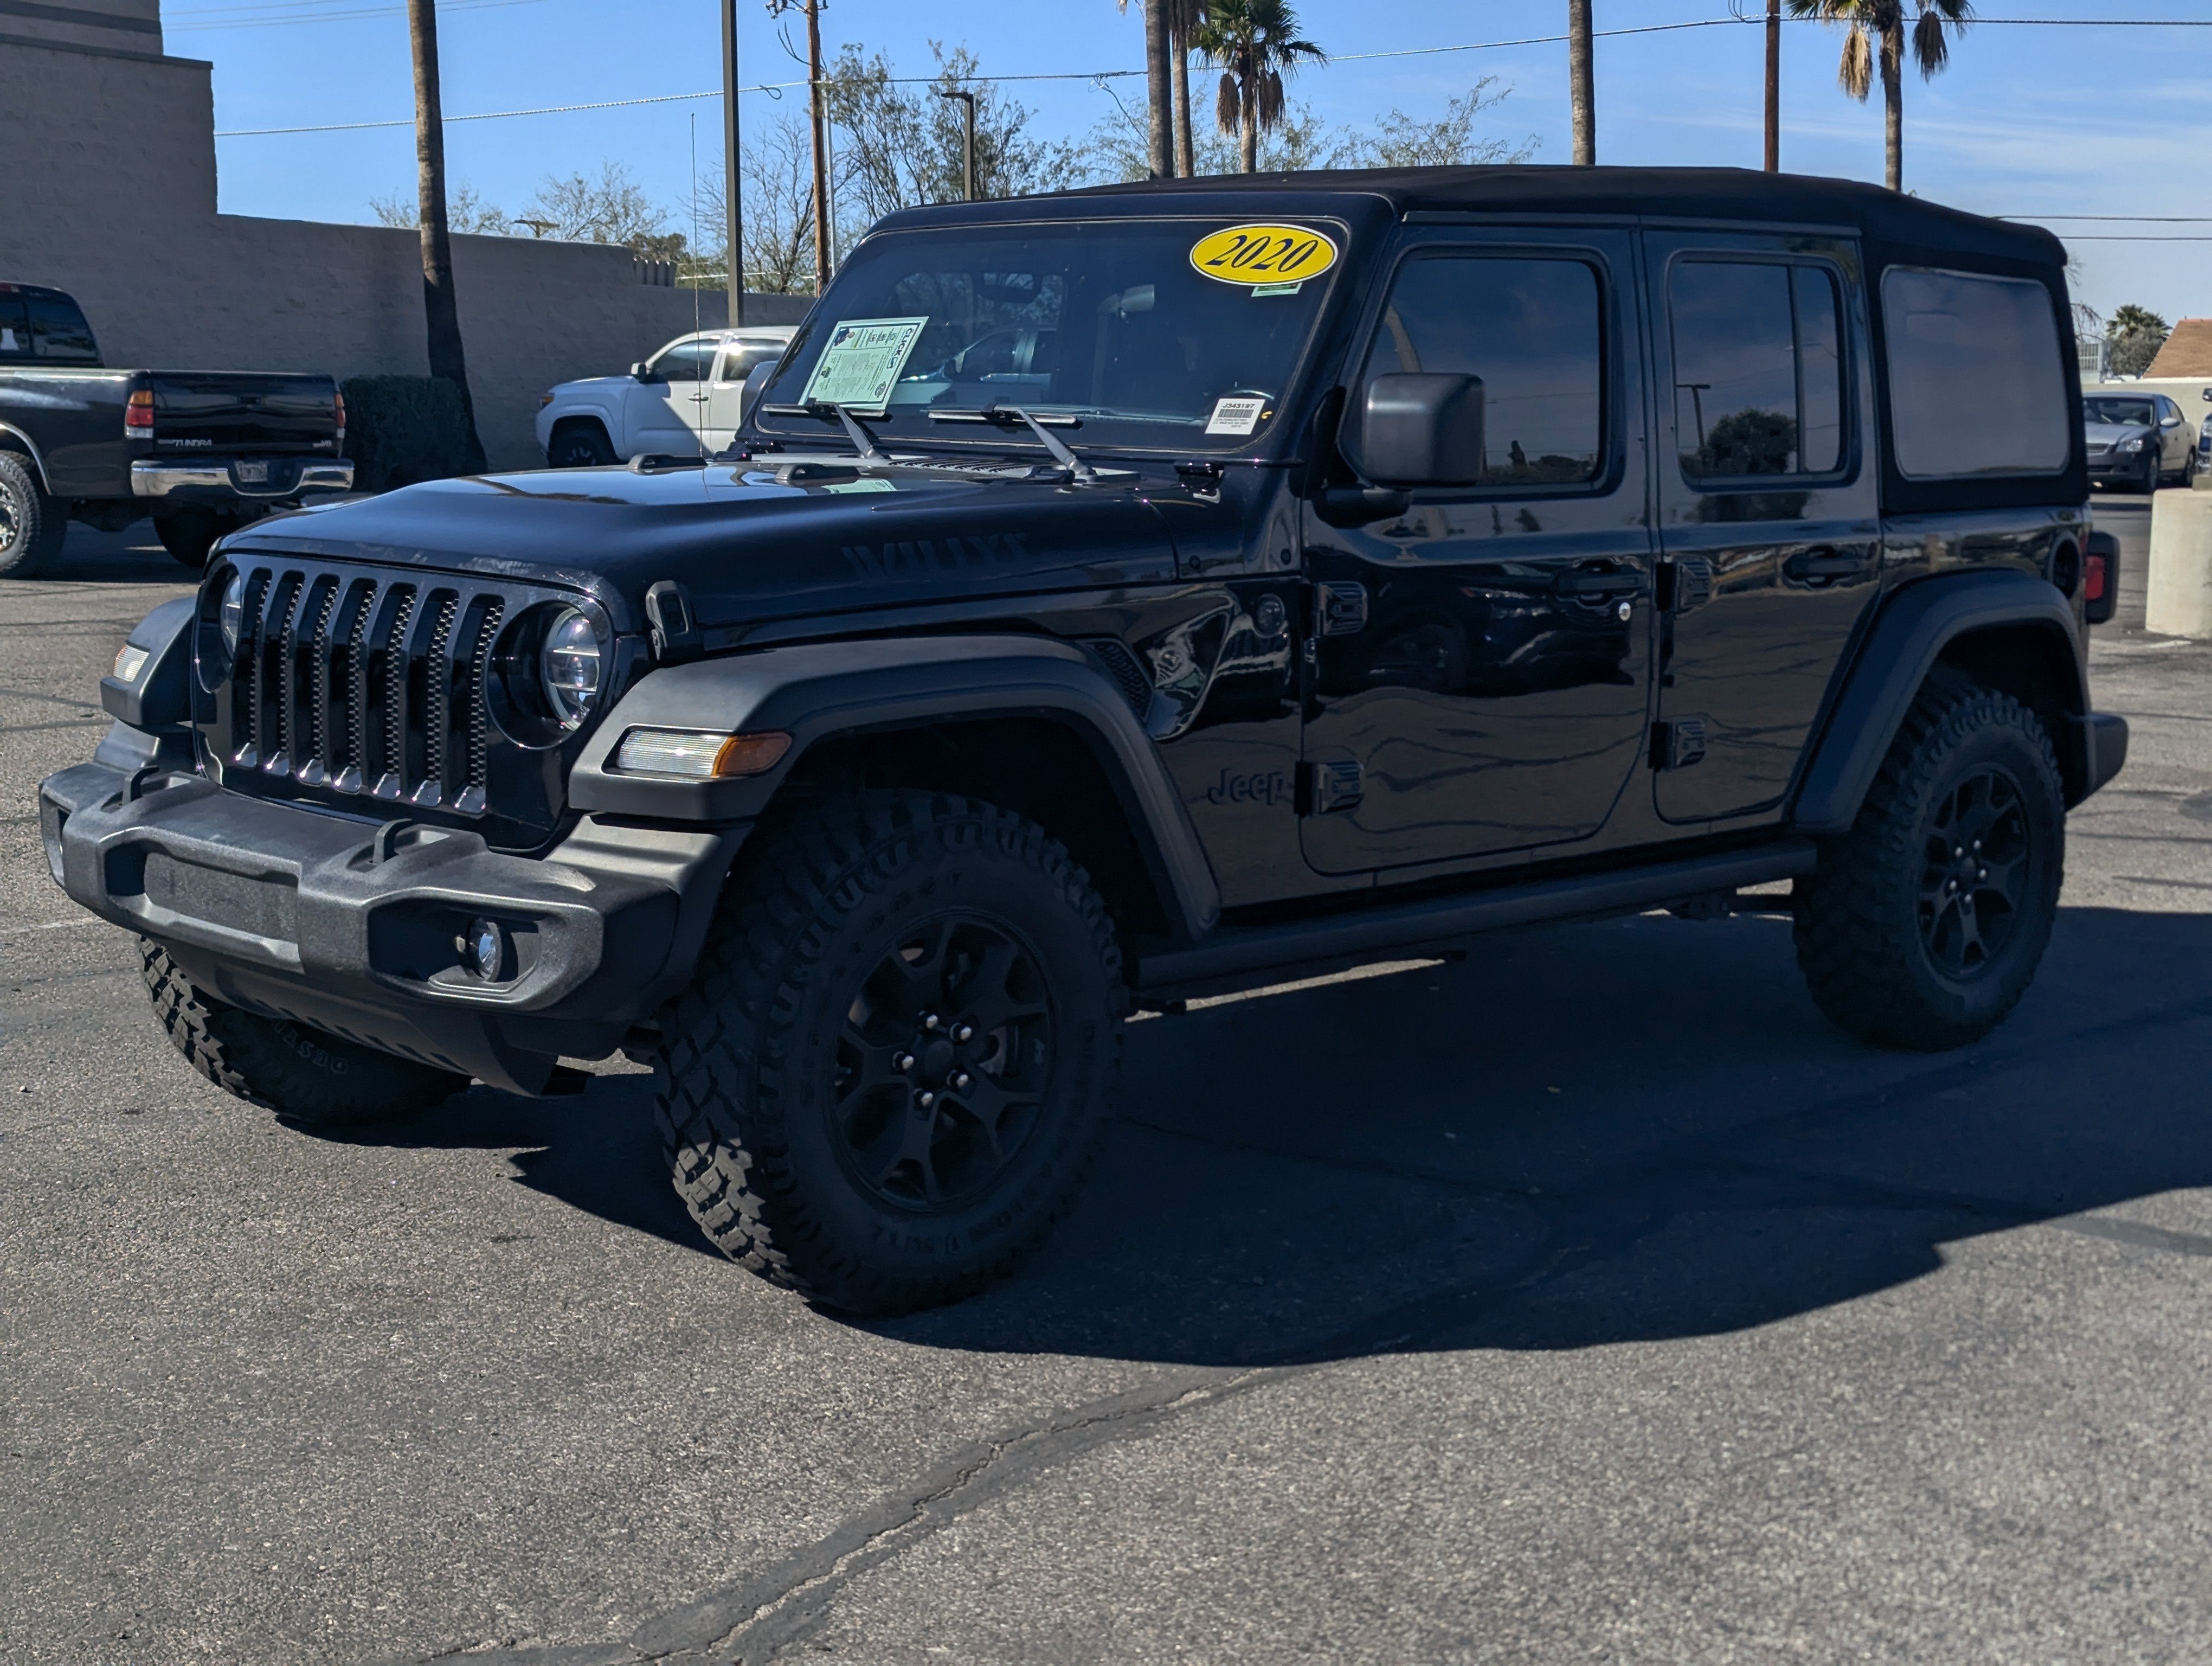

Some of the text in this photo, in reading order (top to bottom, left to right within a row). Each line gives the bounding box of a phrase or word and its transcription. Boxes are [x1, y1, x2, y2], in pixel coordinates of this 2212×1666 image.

[1204, 235, 1319, 272] 2020
[893, 328, 913, 356] CLICK
[1207, 767, 1284, 806] Jeep
